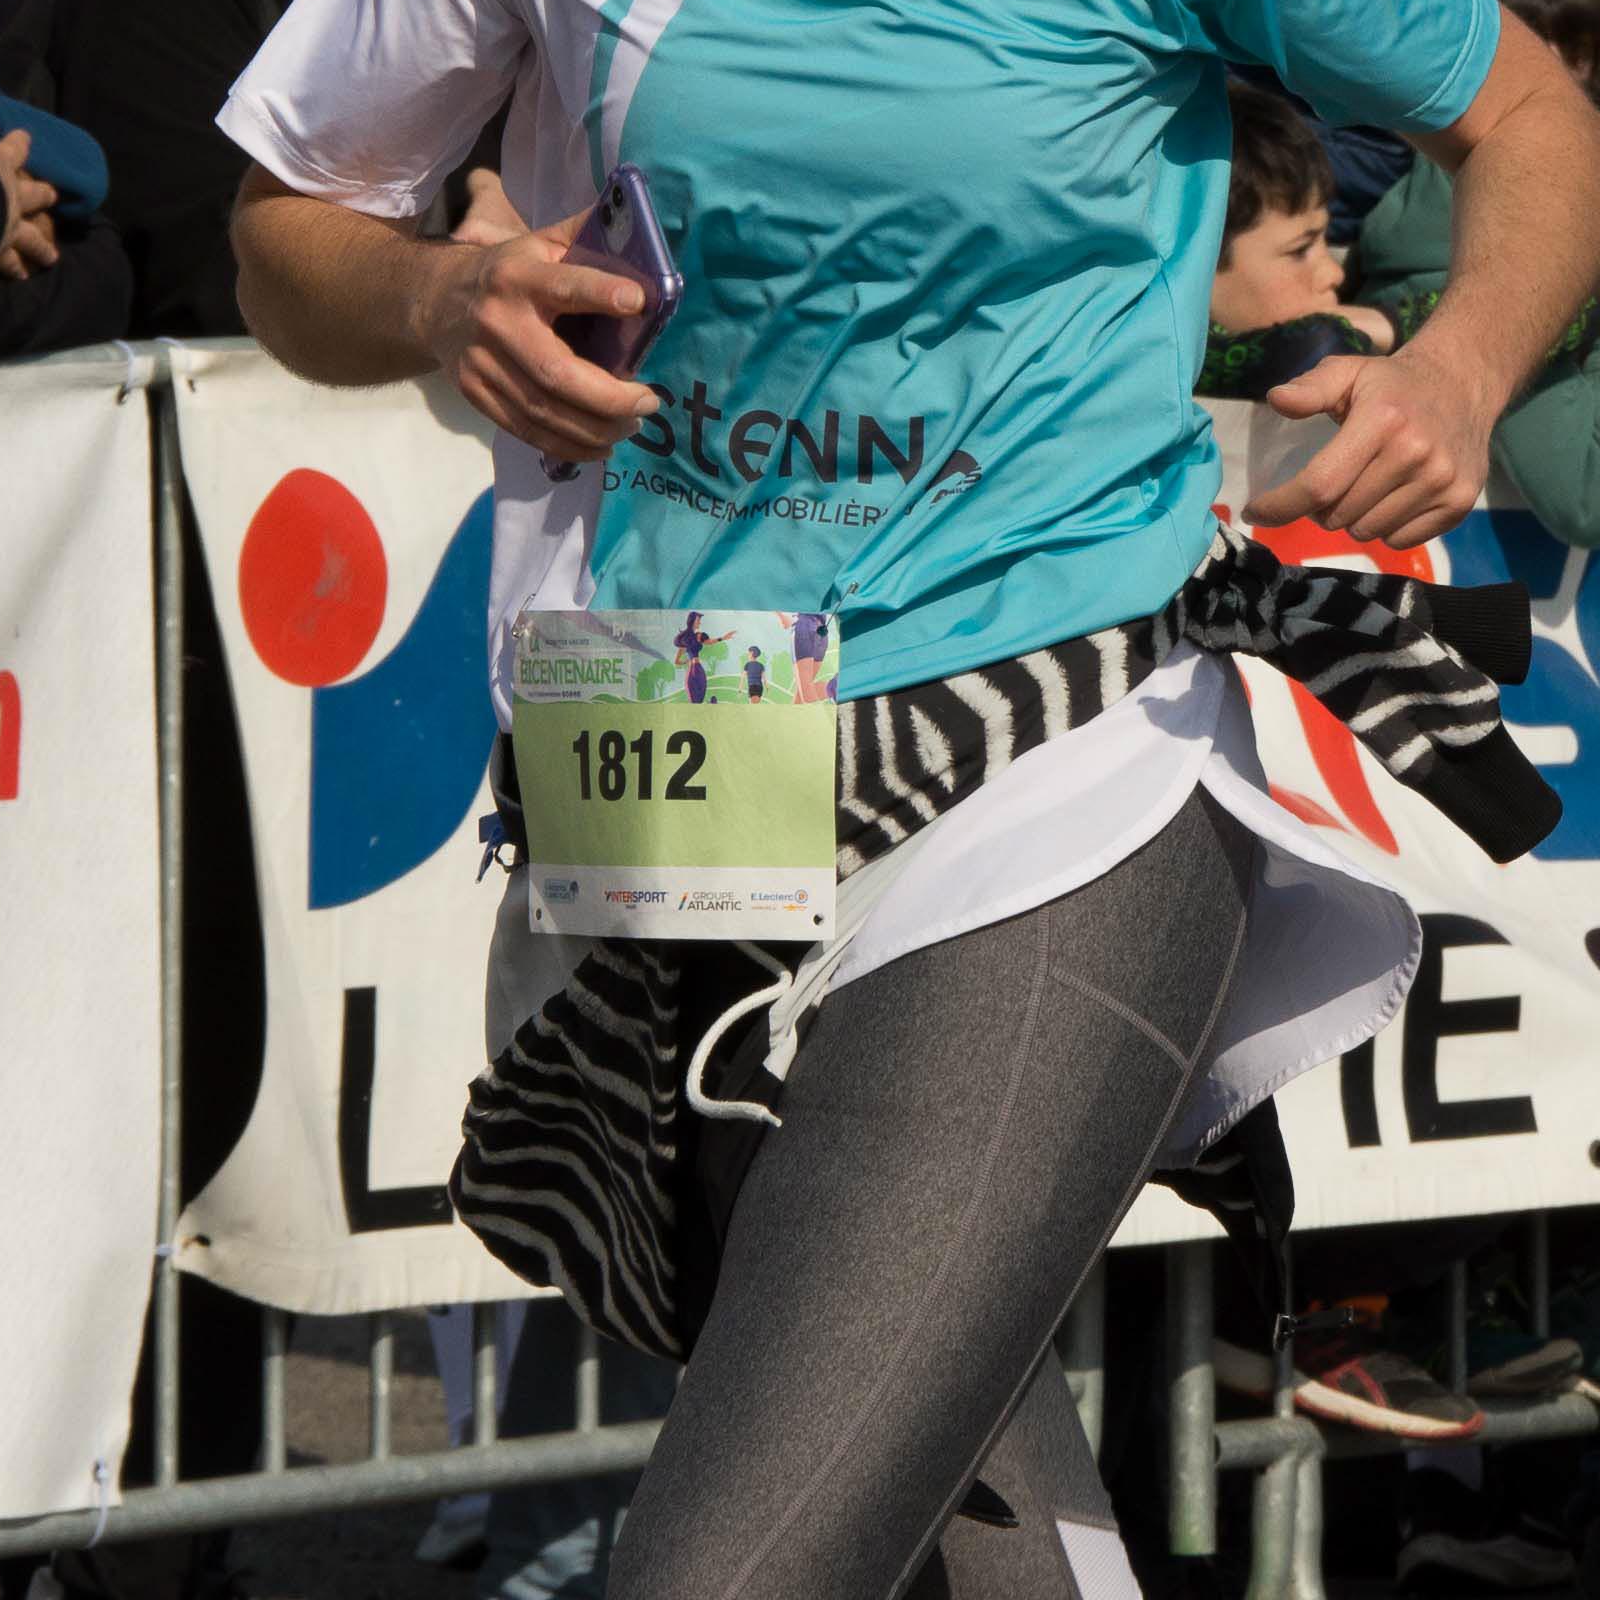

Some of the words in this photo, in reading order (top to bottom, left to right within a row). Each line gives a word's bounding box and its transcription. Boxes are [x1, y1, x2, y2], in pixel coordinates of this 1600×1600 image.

[519, 657, 624, 686] BICENTENAIRE
[572, 729, 708, 802] 1812
[692, 891, 735, 900] GROUPE
[687, 900, 742, 912] ATLANTIC
